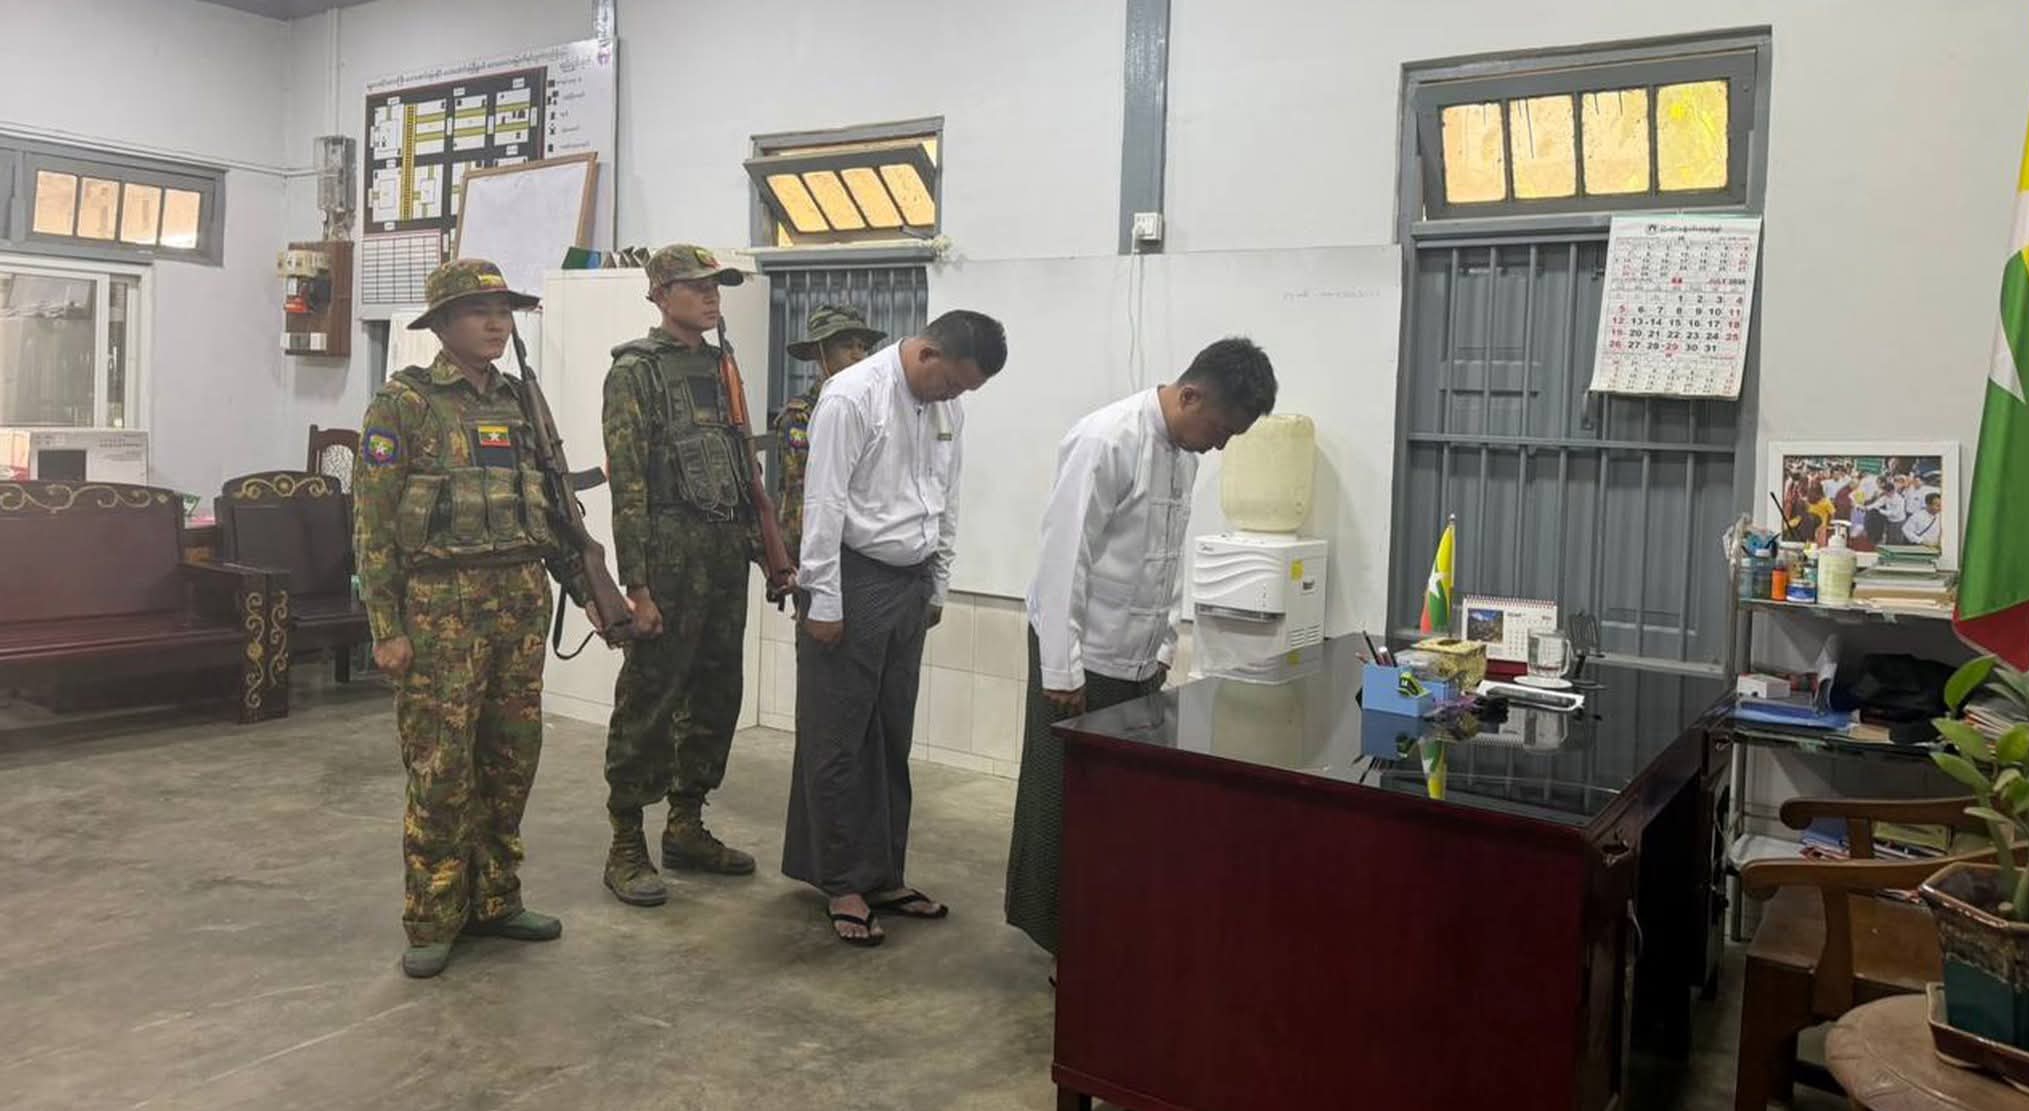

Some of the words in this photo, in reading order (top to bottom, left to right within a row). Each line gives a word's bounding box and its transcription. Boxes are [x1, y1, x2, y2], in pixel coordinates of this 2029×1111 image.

[1709, 308, 1722, 316] 10
[1730, 308, 1741, 317] 11
[1651, 318, 1662, 326] 14
[1708, 320, 1720, 328] 17
[1629, 329, 1642, 337] 20
[1648, 330, 1660, 338] 21
[1667, 331, 1680, 339] 22
[1687, 331, 1699, 340] 23
[1706, 332, 1719, 340] 24
[1628, 341, 1640, 349] 27
[1647, 342, 1659, 350] 28
[1665, 342, 1679, 350] 29
[1686, 343, 1698, 352] 30
[1704, 344, 1717, 352] 31
